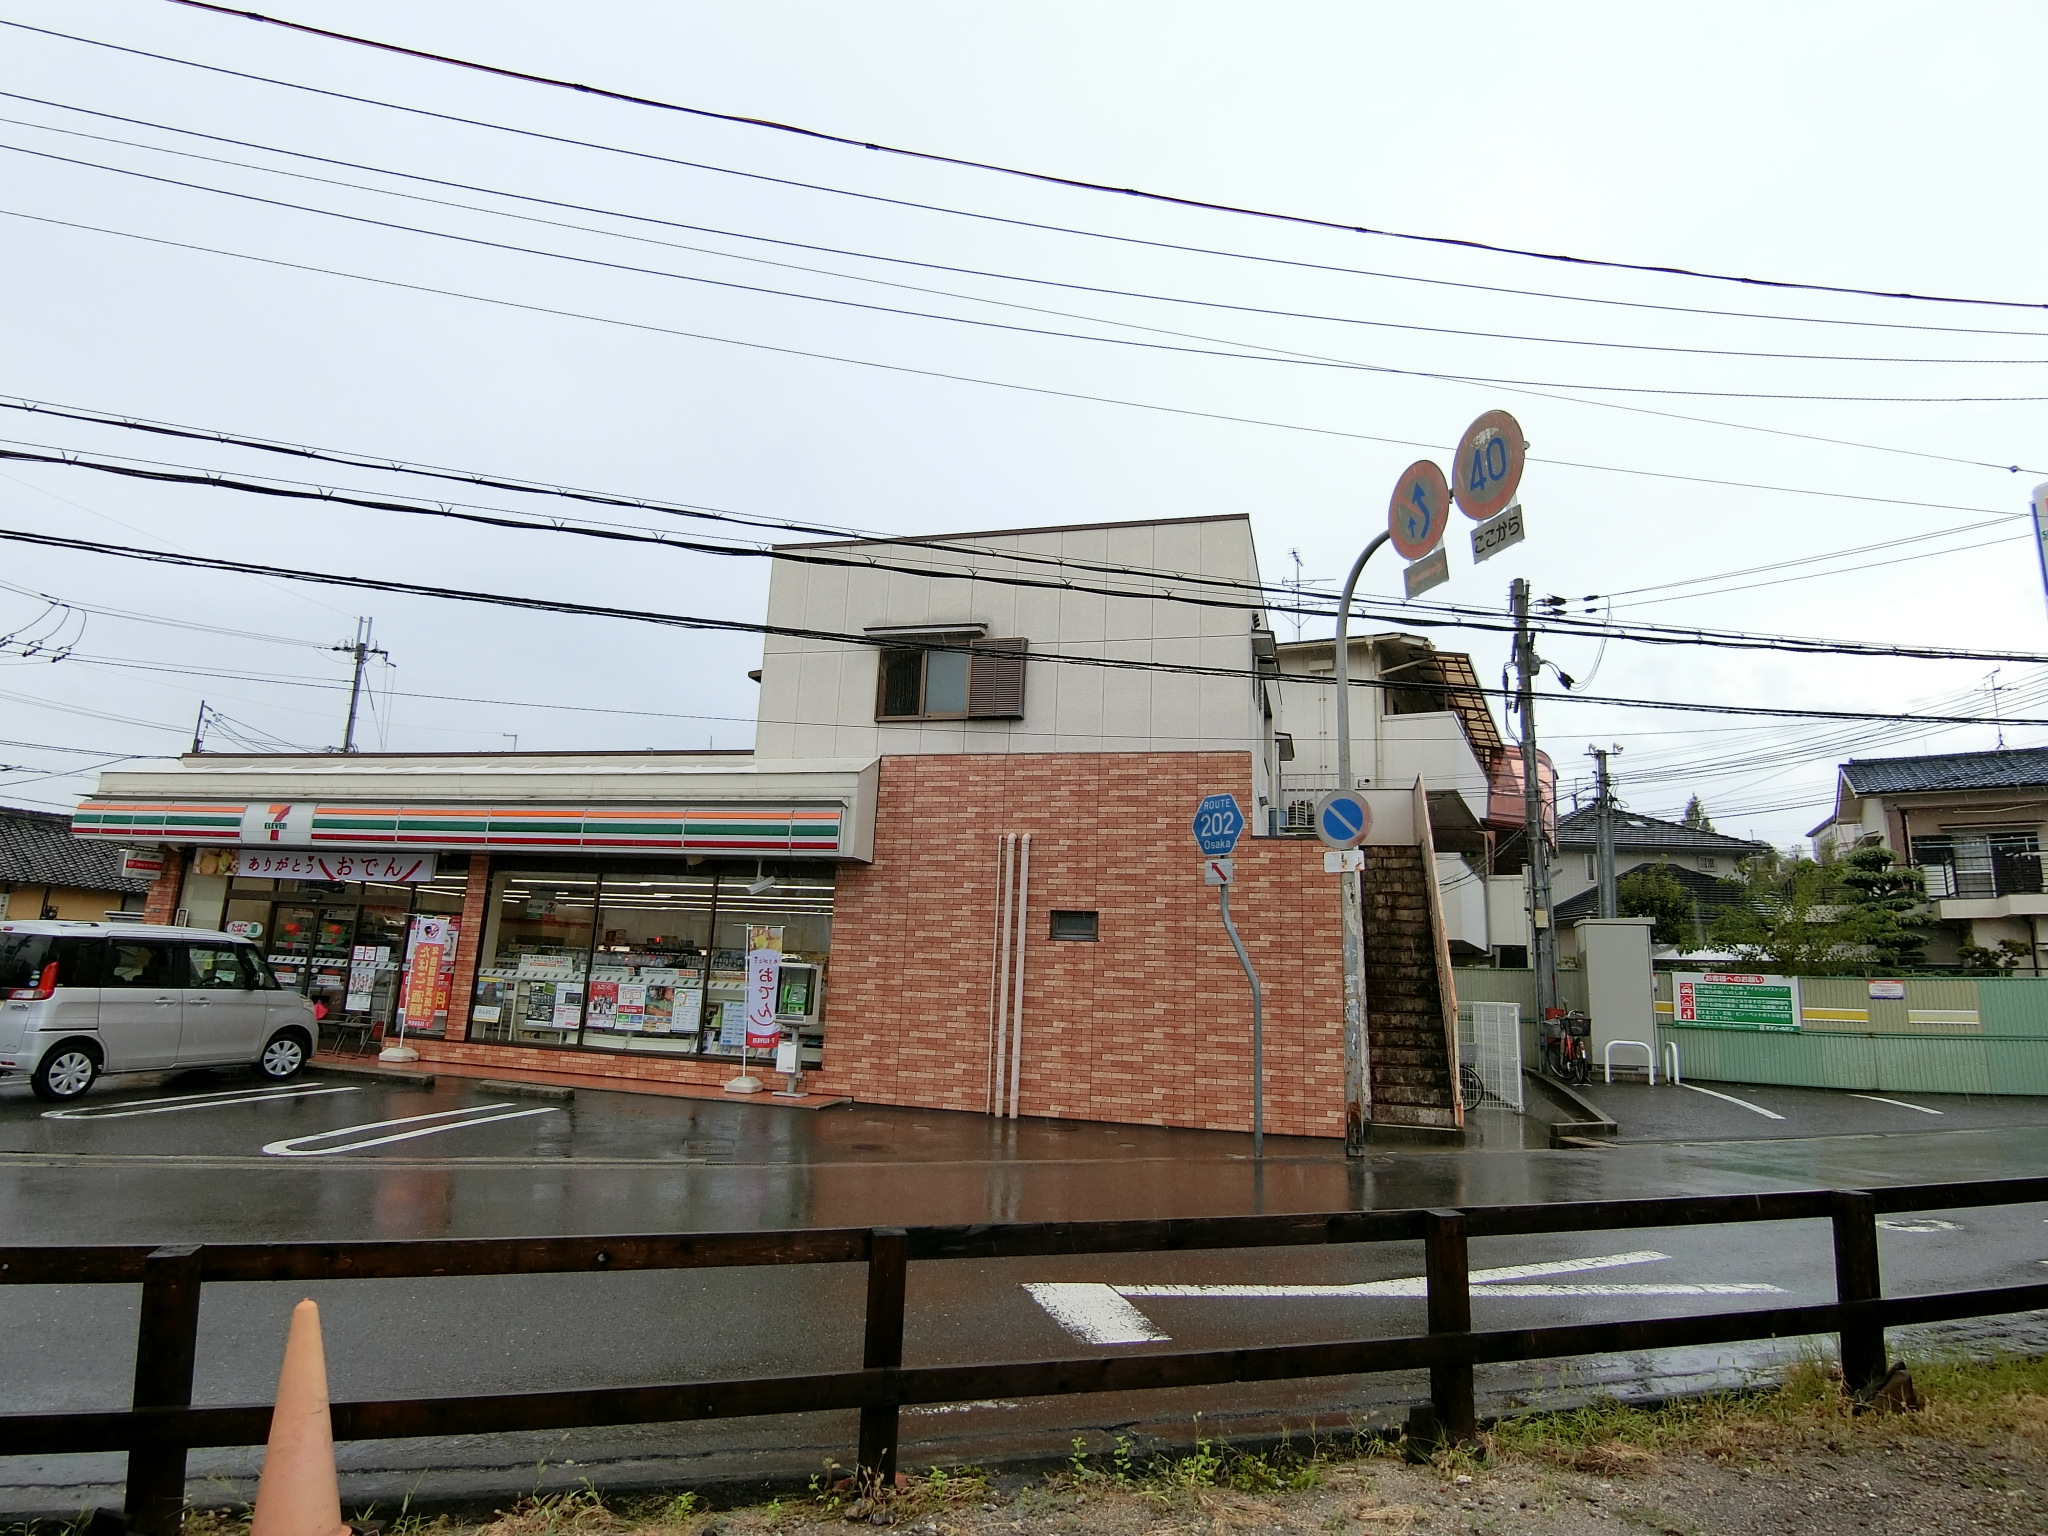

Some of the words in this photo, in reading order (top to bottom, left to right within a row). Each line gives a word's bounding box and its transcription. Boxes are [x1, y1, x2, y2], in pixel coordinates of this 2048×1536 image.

[1470, 437, 1507, 491] 40
[1474, 516, 1520, 554] ここから
[1204, 799, 1231, 810] ROUTE
[1200, 811, 1234, 837] 202
[1204, 839, 1231, 849] Osaka
[248, 857, 315, 873] ありがとう
[337, 856, 403, 877] おでん
